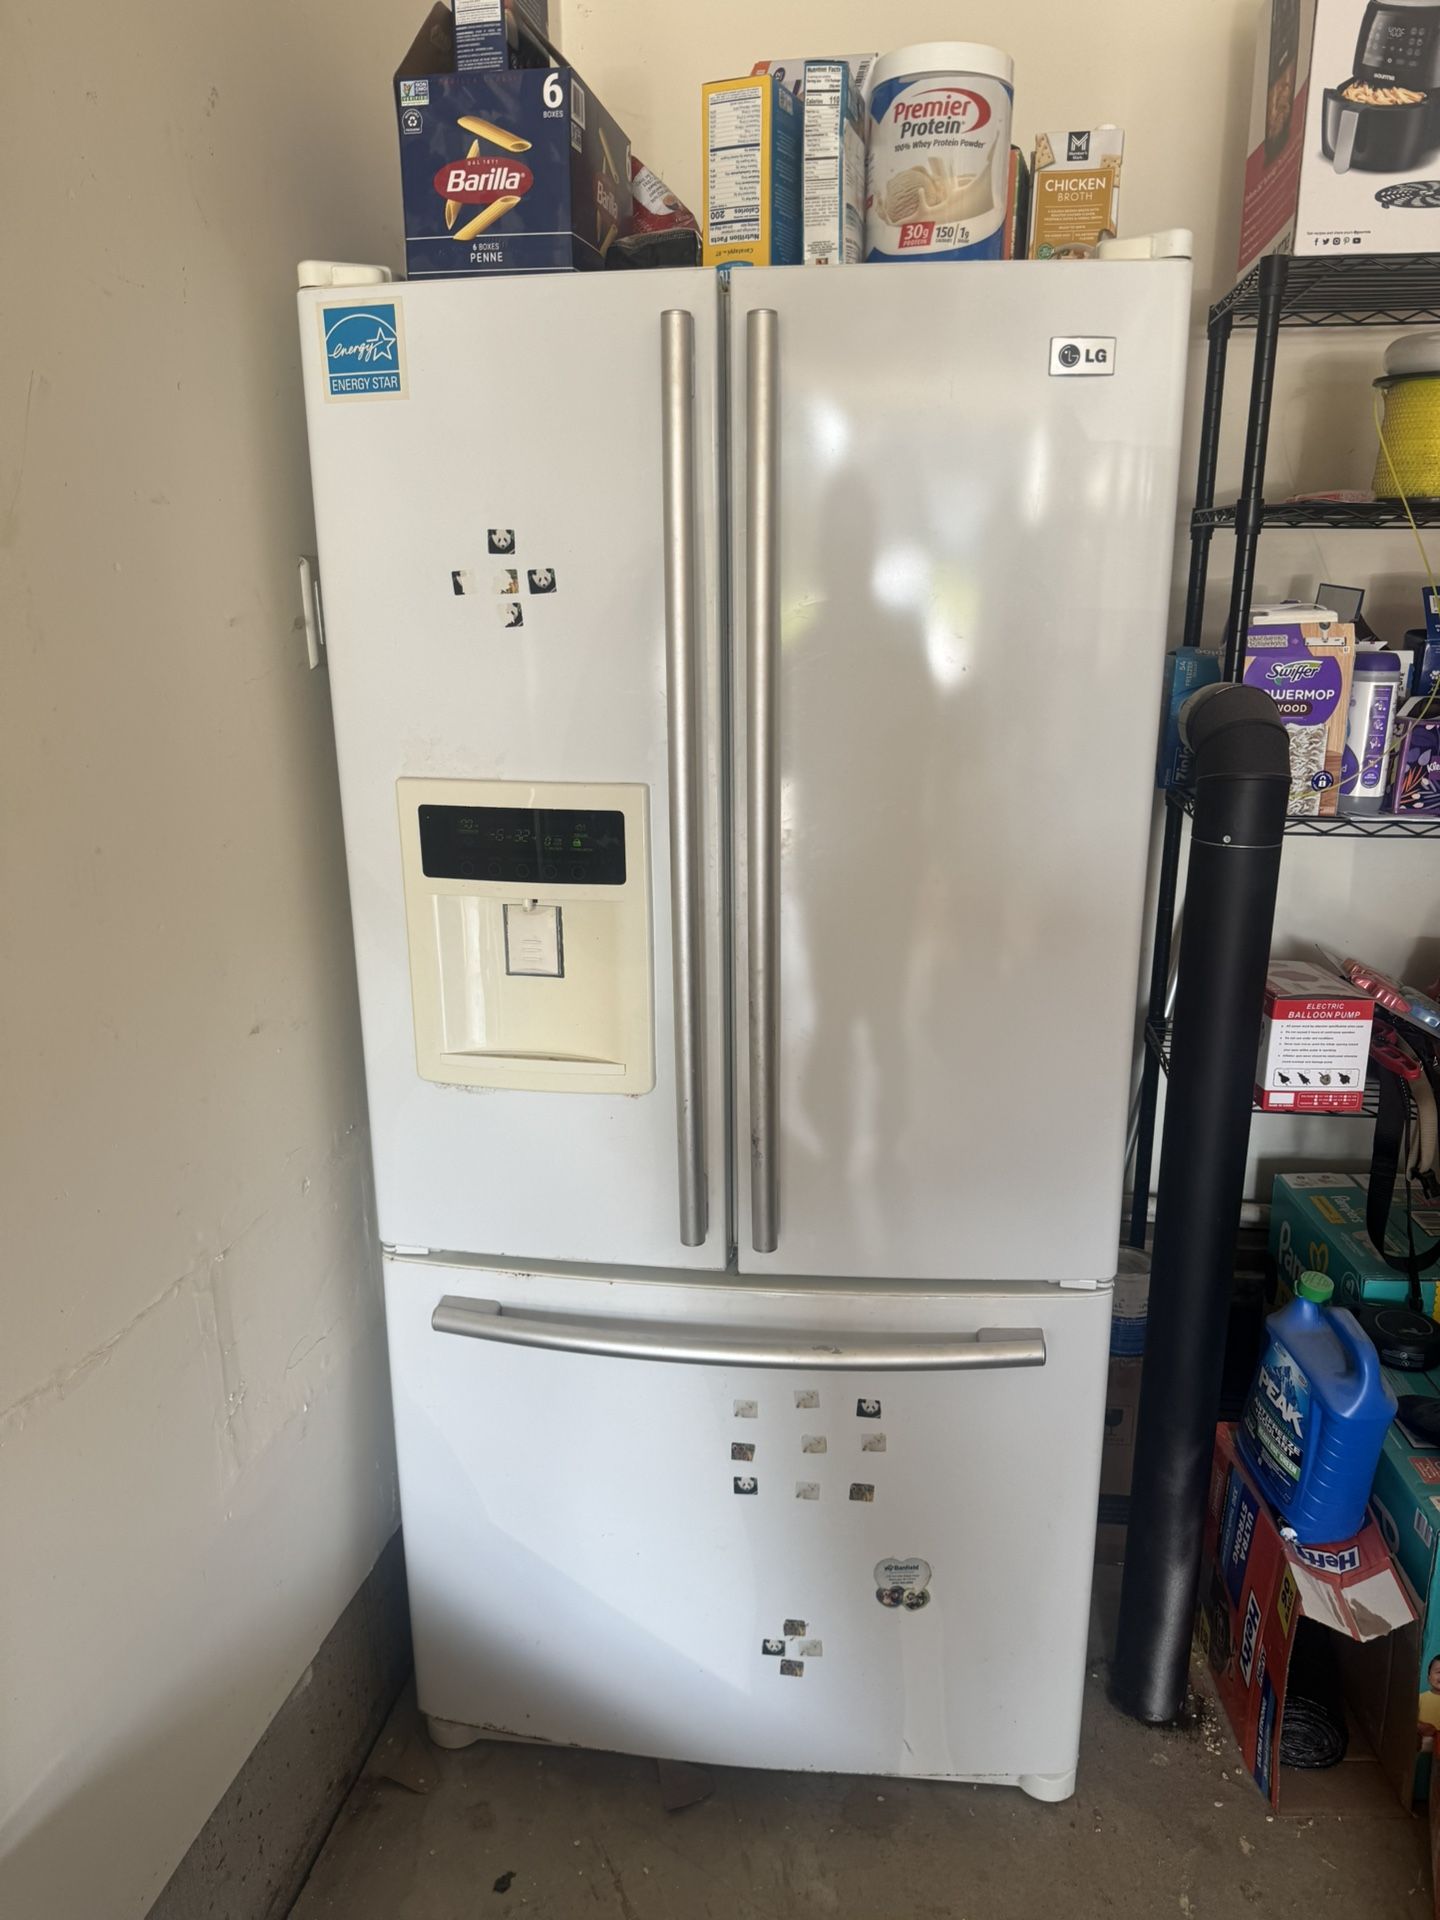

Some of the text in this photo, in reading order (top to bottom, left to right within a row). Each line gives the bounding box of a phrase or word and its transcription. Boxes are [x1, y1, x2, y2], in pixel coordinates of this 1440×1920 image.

[543, 72, 564, 109] 6
[543, 111, 564, 119] BOXES
[894, 94, 972, 124] Premier
[901, 116, 961, 139] Protein
[894, 138, 985, 152] 100% Whey Protein Powder
[447, 167, 521, 193] Barilla
[1045, 177, 1106, 192] CHICKEN
[1057, 192, 1093, 202] BROTH
[710, 210, 726, 220] 200
[729, 233, 760, 241] Nutrition
[904, 224, 970, 240] 30g 150 1g
[472, 243, 500, 251] 6 BOXES
[470, 252, 504, 263] PENNE
[1085, 348, 1107, 363] LG
[332, 376, 398, 391] ENERGY STAR
[1265, 662, 1320, 682] Swiffer
[1264, 689, 1335, 700] WERMOP
[1288, 1011, 1361, 1019] BALLOON PUMP
[1259, 1365, 1304, 1440] PEAK
[1232, 1501, 1248, 1566] STRONG
[1240, 1511, 1255, 1561] ULTRA
[1241, 1598, 1261, 1675] Hefty
